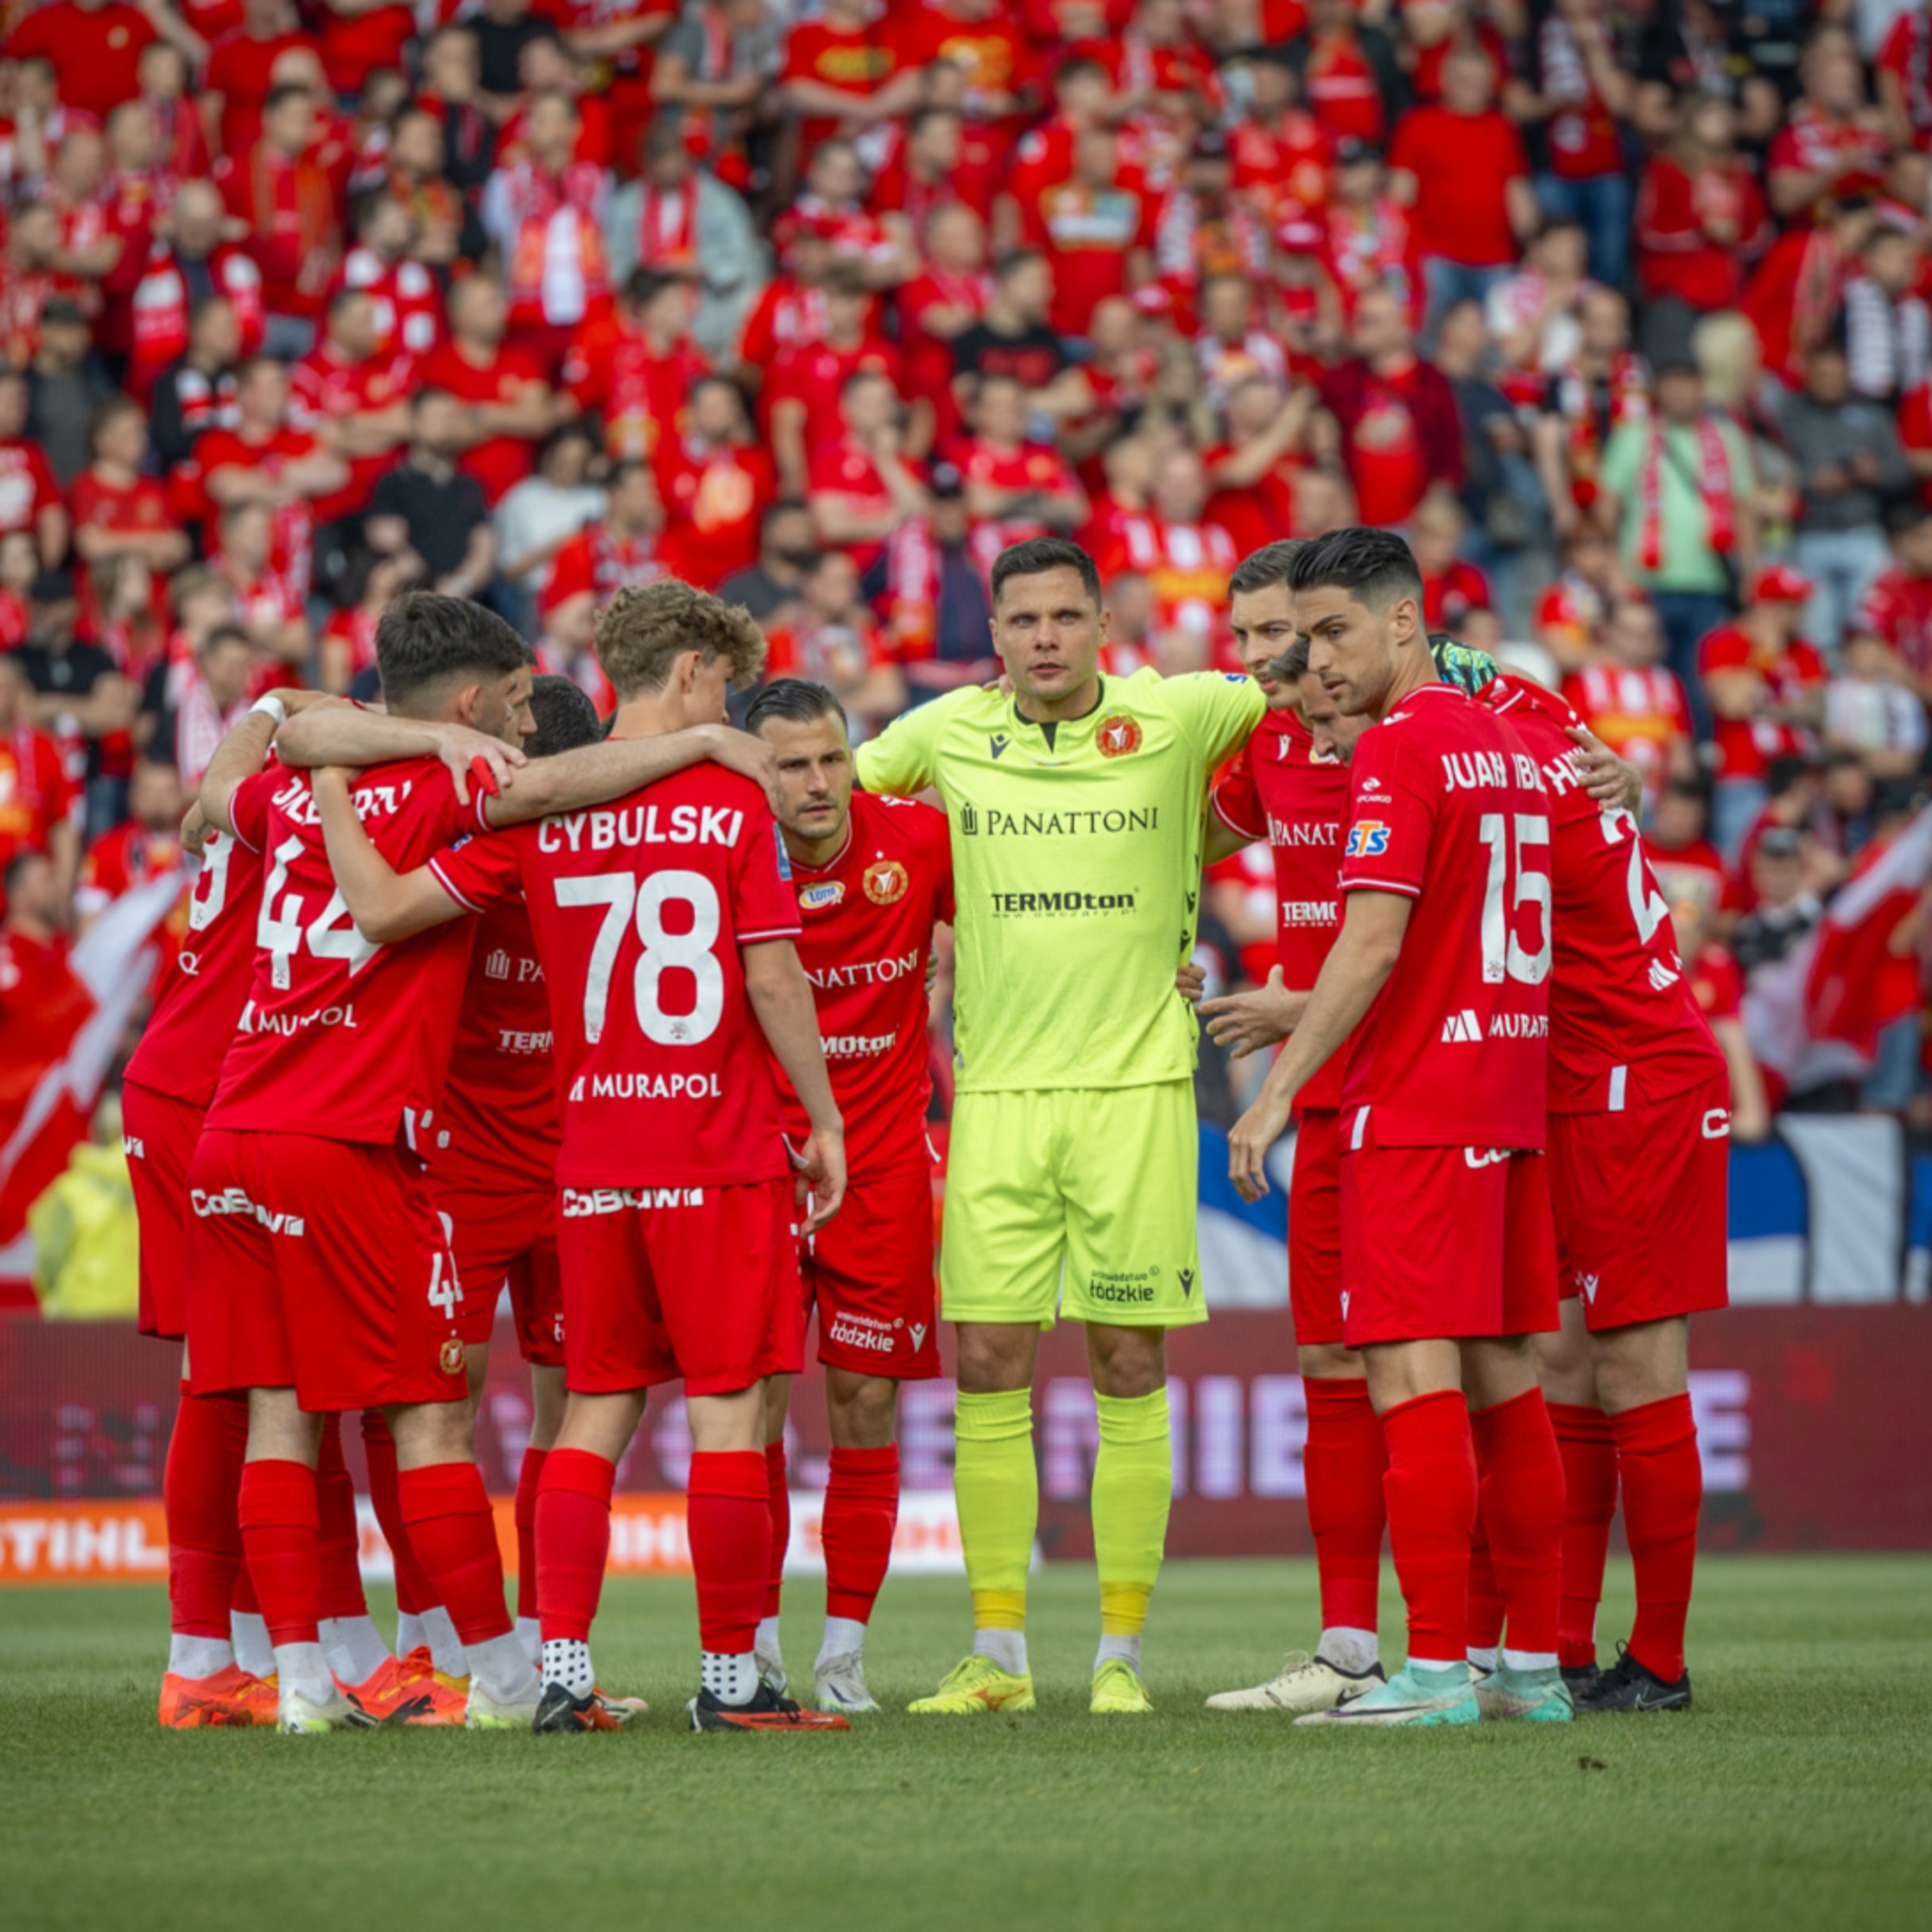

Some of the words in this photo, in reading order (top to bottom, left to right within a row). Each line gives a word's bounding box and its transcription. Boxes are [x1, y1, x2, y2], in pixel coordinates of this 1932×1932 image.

[1441, 751, 1508, 792] JUAN
[538, 805, 743, 853] CYBULSKI
[987, 807, 1159, 836] PANATTONI
[1346, 820, 1392, 857] STS
[256, 833, 386, 991] 44
[810, 887, 836, 903] LOTTO
[991, 892, 1135, 912] TERMOton
[1480, 813, 1553, 985] 15
[554, 869, 724, 1045] 78
[592, 1074, 722, 1099] MURAPOL
[0, 1517, 167, 1570] TIHL
